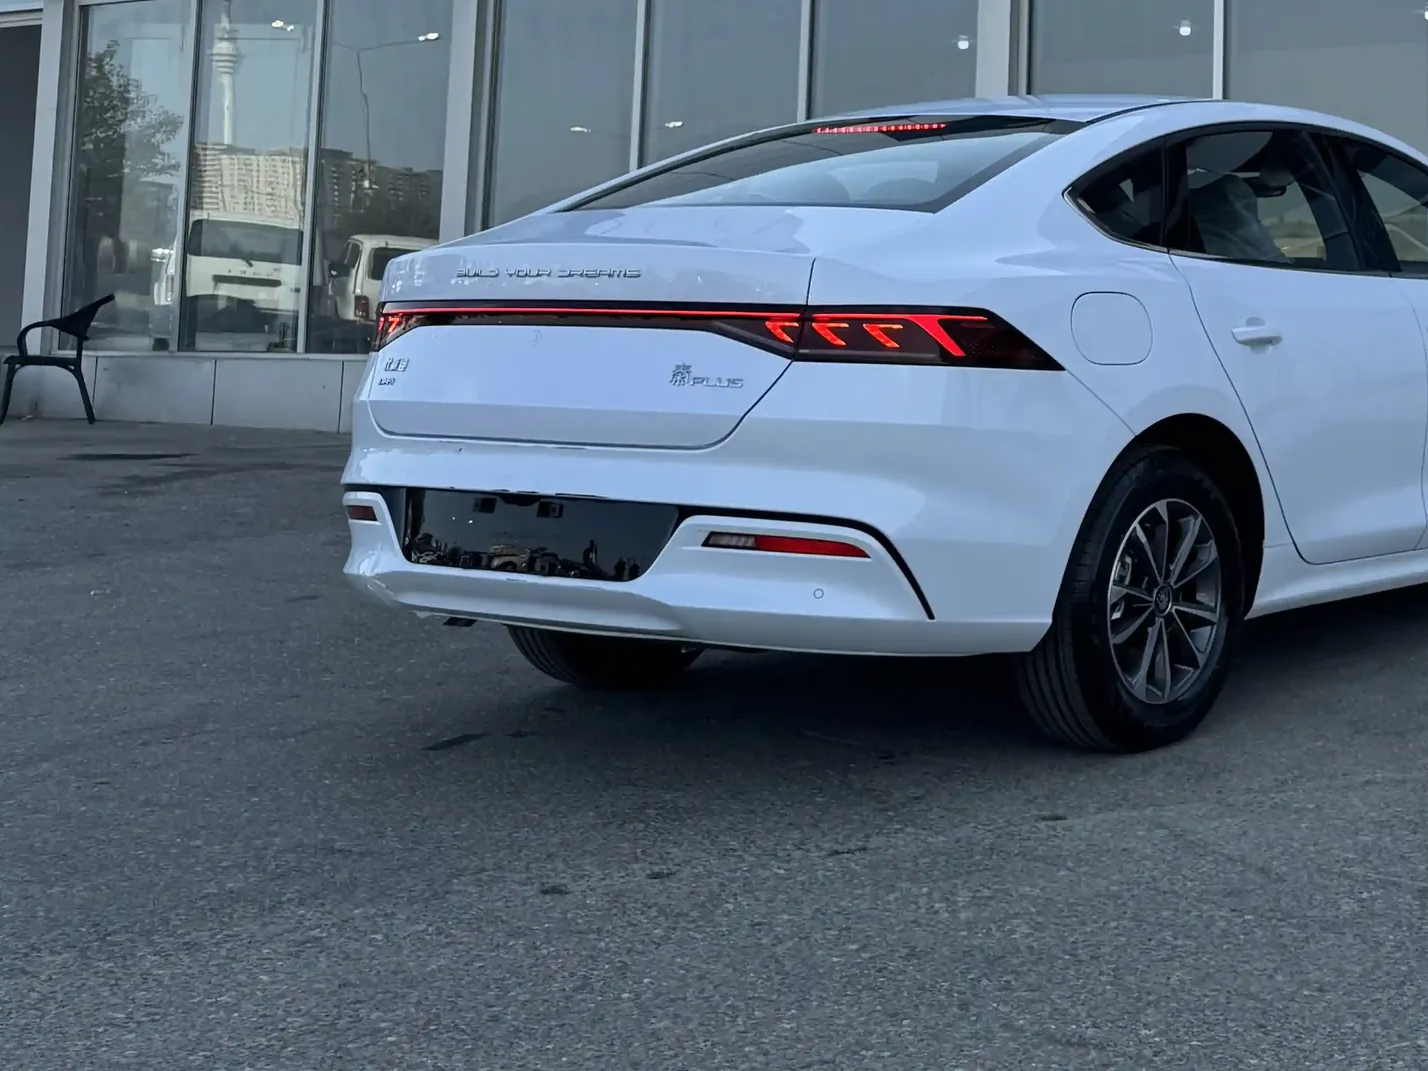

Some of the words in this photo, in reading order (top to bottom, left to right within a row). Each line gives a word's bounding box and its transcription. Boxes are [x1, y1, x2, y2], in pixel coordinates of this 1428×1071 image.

[456, 268, 500, 278] BUILD
[504, 268, 551, 278] YOUR
[557, 268, 642, 279] DREAMS
